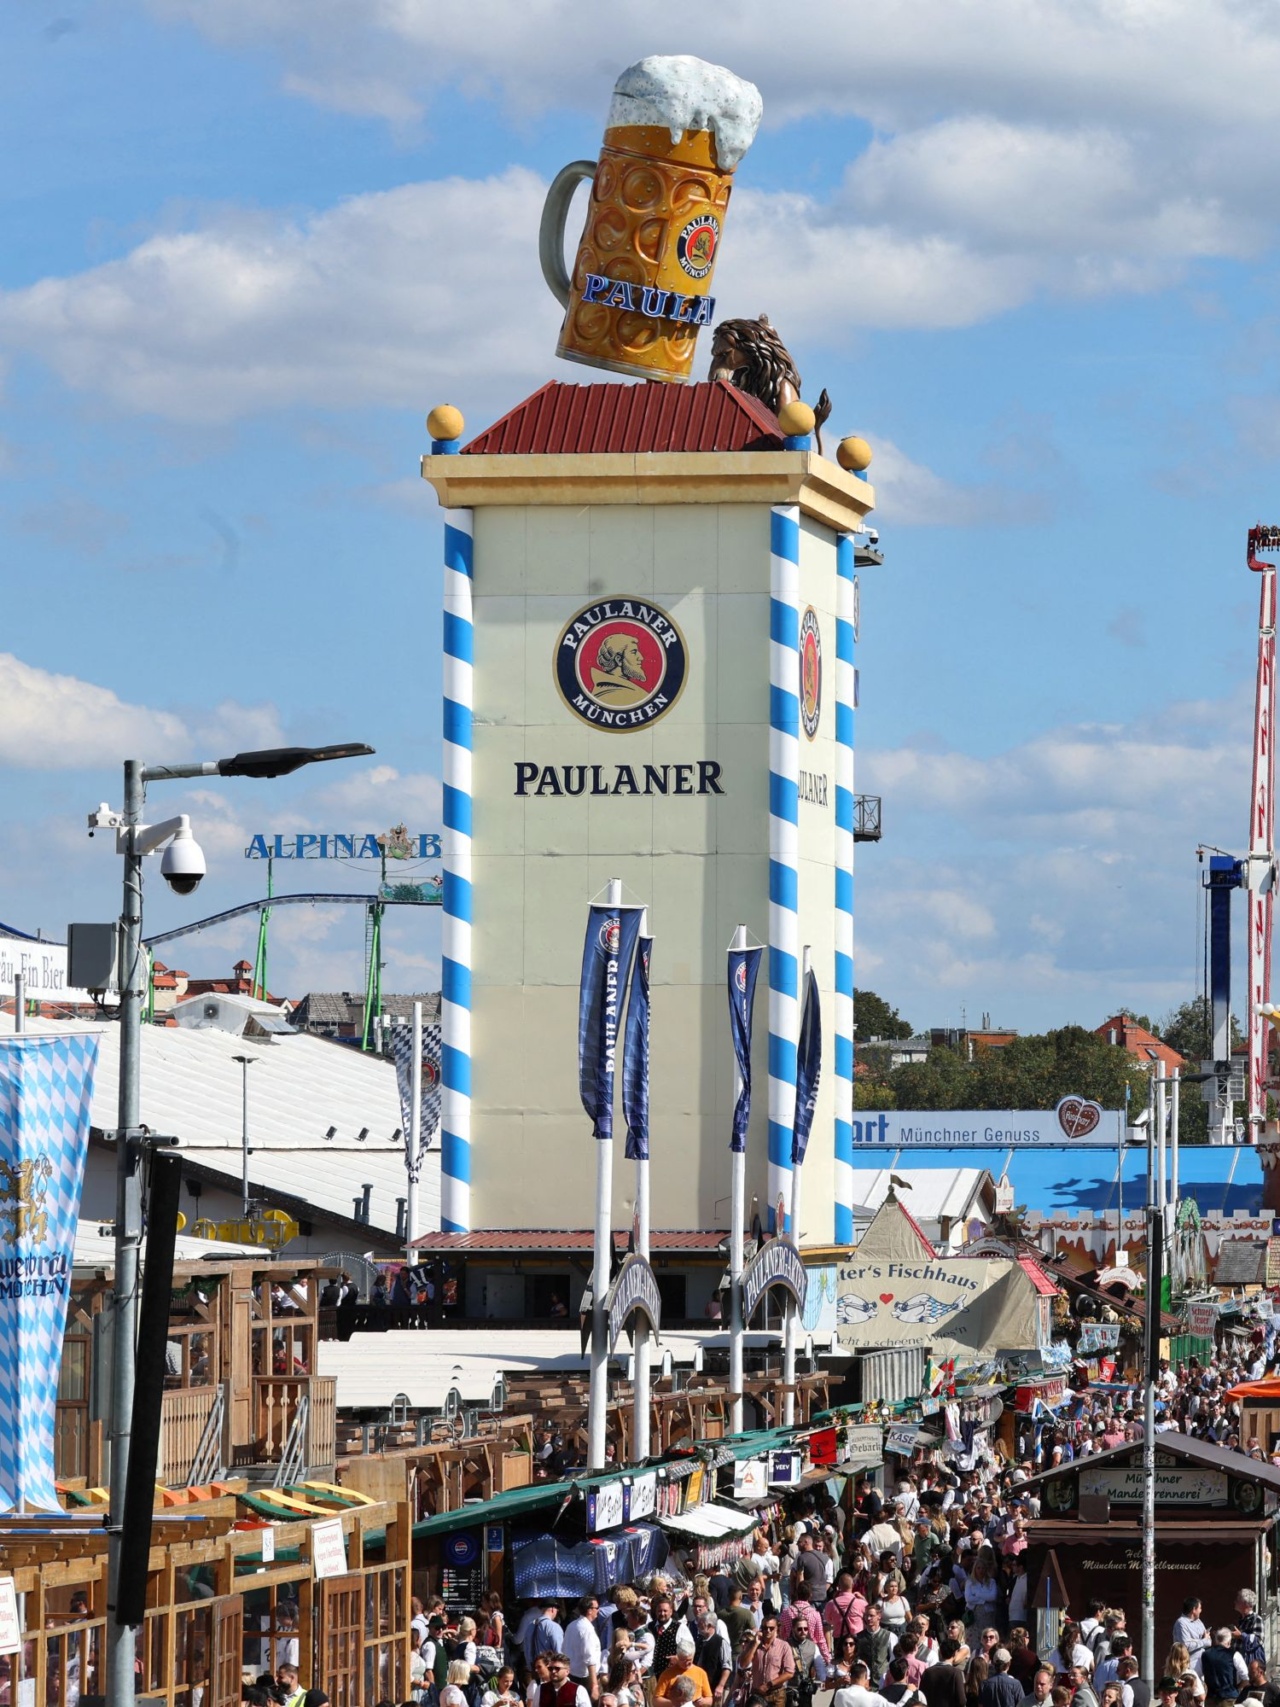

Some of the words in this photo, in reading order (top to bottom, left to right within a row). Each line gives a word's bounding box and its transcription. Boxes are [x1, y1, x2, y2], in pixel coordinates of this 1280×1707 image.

[562, 602, 678, 650] PAULANER
[572, 693, 669, 725] MÜNCHEN
[514, 760, 726, 797] PAULANER
[247, 834, 382, 858] ALPINA
[41, 955, 65, 990] Bier
[900, 1127, 978, 1142] Münchner
[984, 1127, 1040, 1142] Genuss
[888, 1263, 979, 1291] Fischhaus
[873, 1337, 924, 1348] scheene
[775, 1463, 790, 1471] VEEV
[1125, 1472, 1182, 1484] Mühner
[1107, 1487, 1201, 1500] Manderennerei
[1082, 1560, 1127, 1571] Münchner
